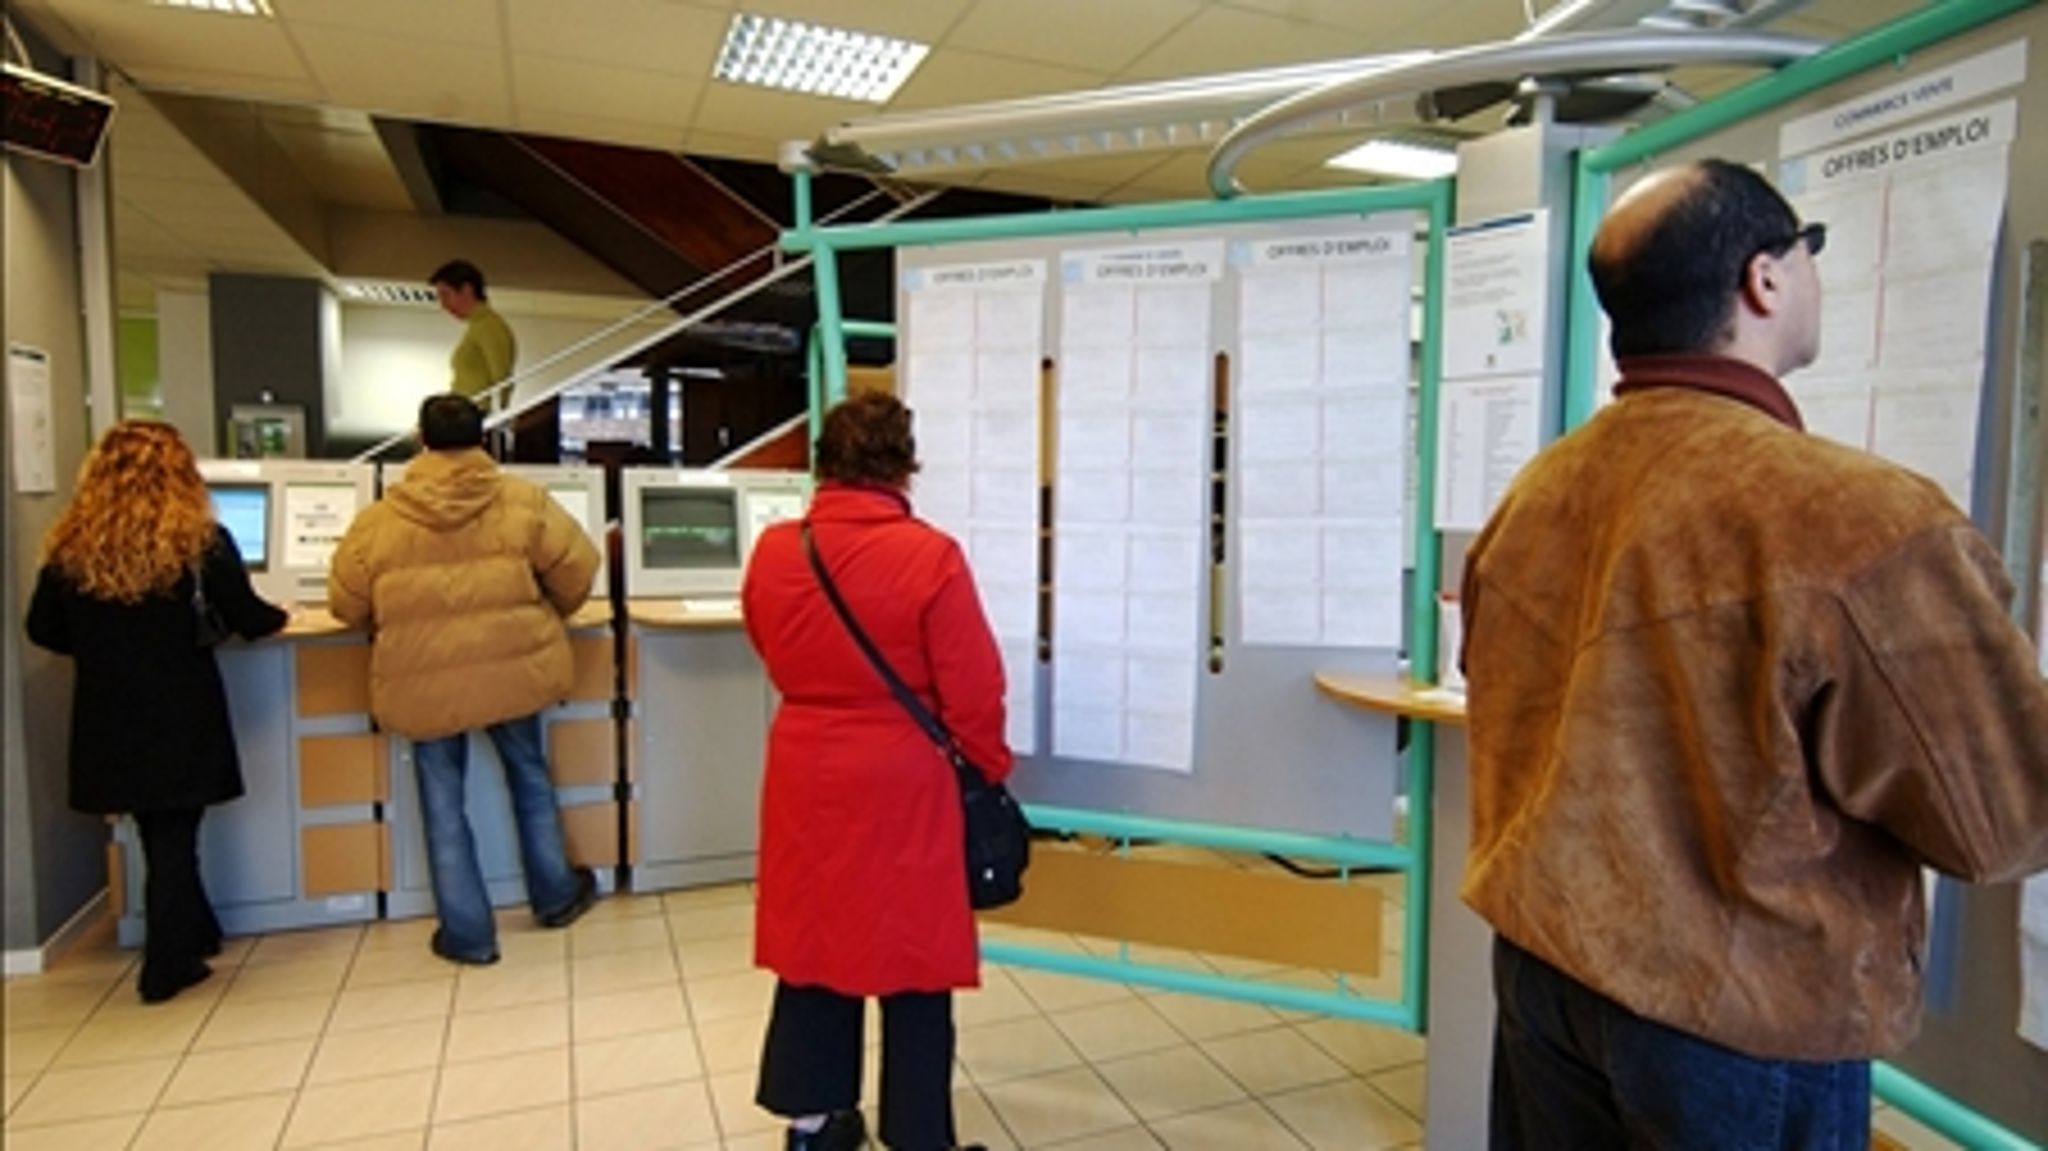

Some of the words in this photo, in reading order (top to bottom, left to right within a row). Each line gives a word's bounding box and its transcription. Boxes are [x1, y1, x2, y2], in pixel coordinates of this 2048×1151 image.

[1822, 141, 1889, 178] OFFRES
[1893, 117, 1990, 160] D'EMPLOI
[1266, 242, 1320, 260] OFFRES
